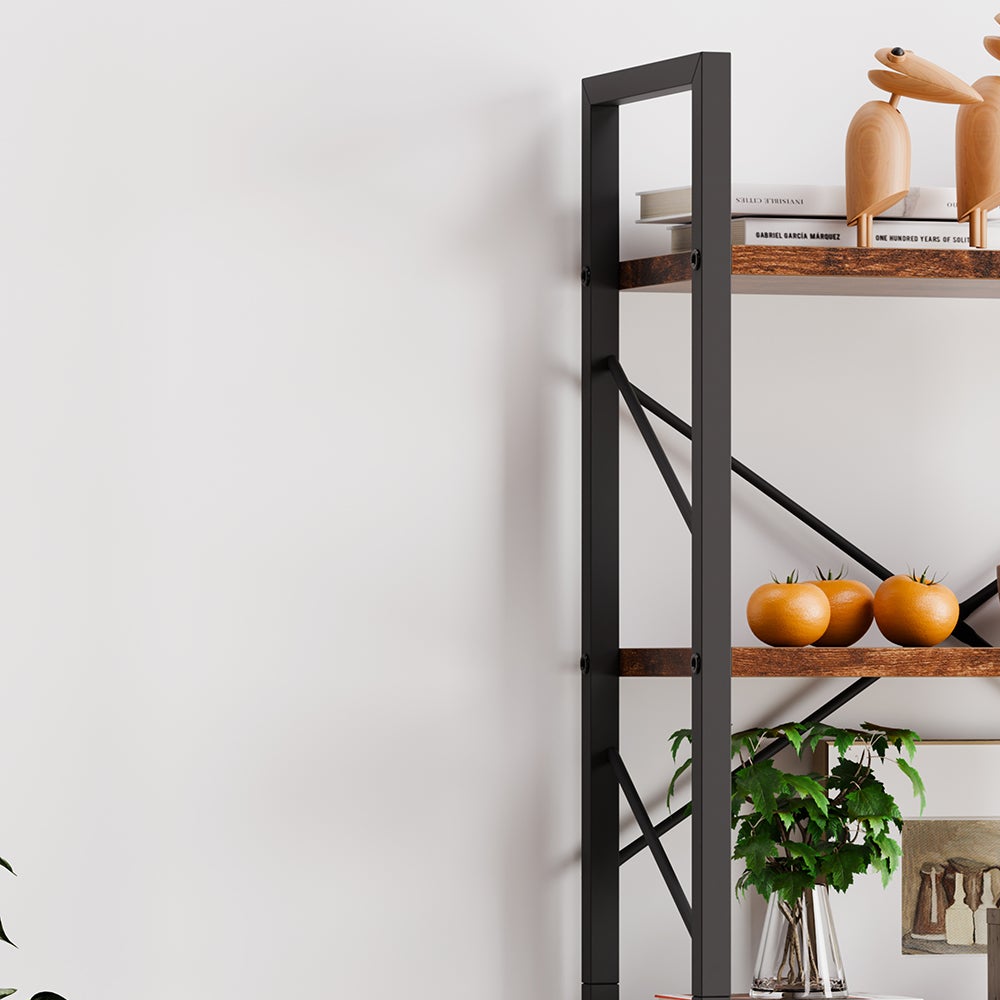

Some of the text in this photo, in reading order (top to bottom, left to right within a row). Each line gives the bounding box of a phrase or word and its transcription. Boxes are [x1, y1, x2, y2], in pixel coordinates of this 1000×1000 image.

[764, 197, 804, 205] INVISIBLE
[755, 231, 841, 241] GABRIEL GARCÍA MÁRQUEZ
[875, 234, 888, 242] ONE
[889, 234, 919, 243] HUNDRED
[920, 235, 940, 243] YEARS
[952, 236, 970, 244] SOLIT
